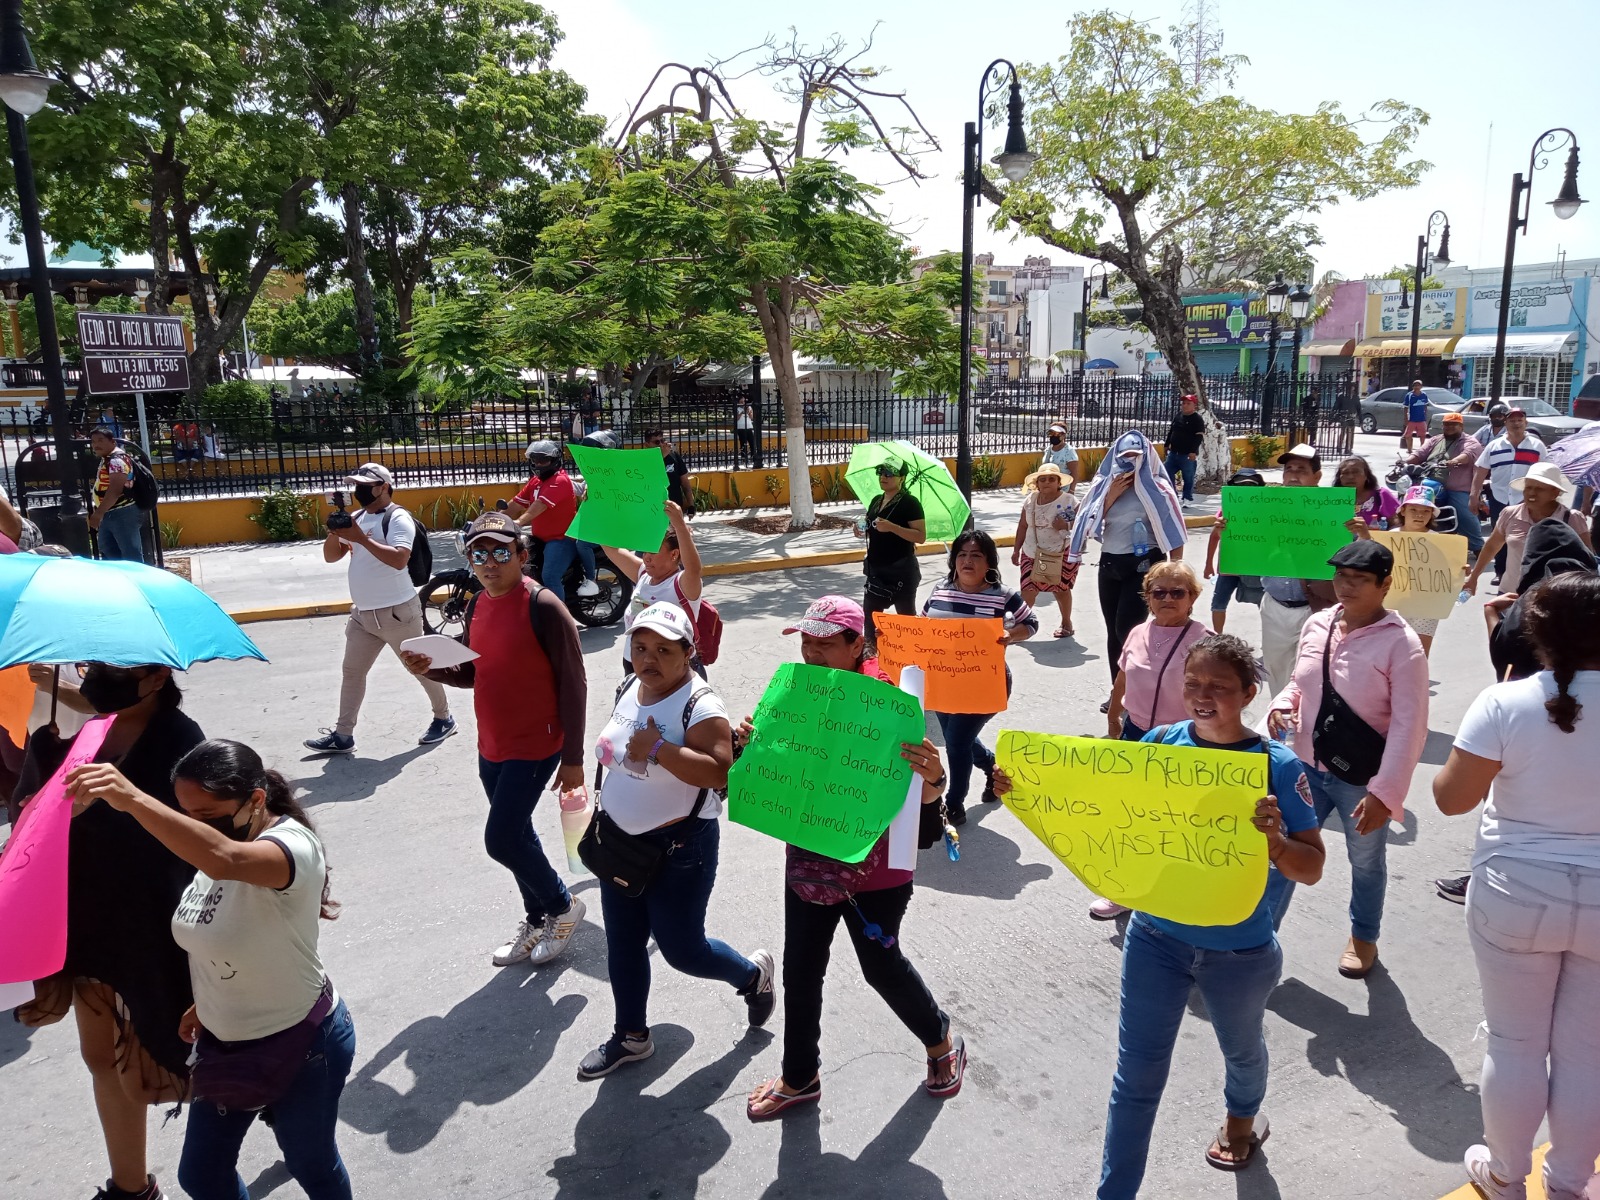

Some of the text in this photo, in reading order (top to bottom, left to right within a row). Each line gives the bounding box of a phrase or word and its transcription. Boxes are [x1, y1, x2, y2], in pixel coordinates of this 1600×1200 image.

[82, 319, 106, 346] CEDA
[107, 320, 120, 346] EL
[121, 321, 141, 346] PASO
[143, 322, 153, 346] AL
[1417, 347, 1435, 355] NDY
[101, 359, 179, 374] MULTA 3 MIL PESOS
[1390, 536, 1430, 565] MAS
[1392, 565, 1452, 594] IDACION
[639, 608, 677, 623] CAREN
[876, 615, 976, 642] Exigimos respeto
[954, 645, 989, 661] gente
[806, 673, 846, 702] lugares
[859, 690, 885, 713] que
[890, 697, 915, 718] nos
[777, 733, 829, 761] estamos
[840, 748, 904, 782] dañando
[1001, 731, 1134, 775] PEDIMOS
[800, 767, 816, 791] los
[738, 787, 883, 840] nos estan abriendo Puert
[1007, 789, 1101, 818] EXIMOS
